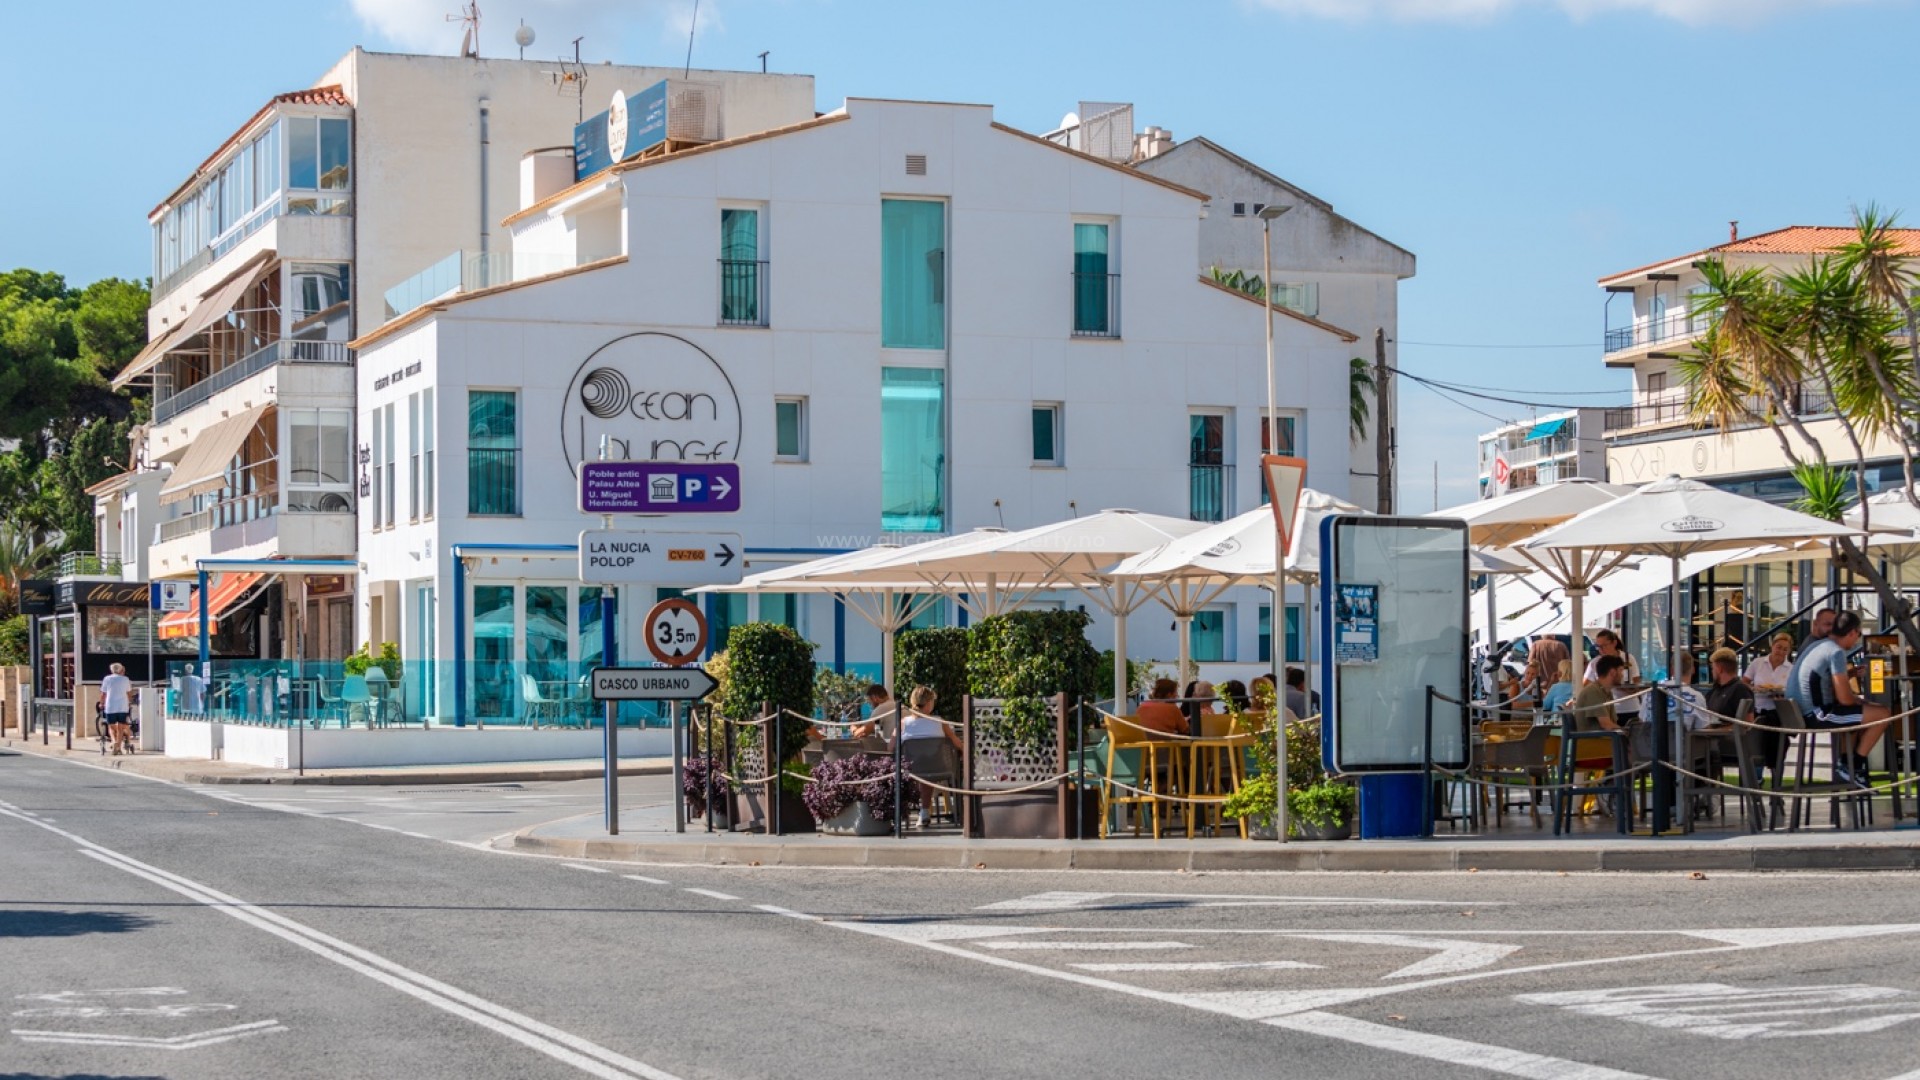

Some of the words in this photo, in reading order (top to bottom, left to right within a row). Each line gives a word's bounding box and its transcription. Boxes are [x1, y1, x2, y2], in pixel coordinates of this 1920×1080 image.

[580, 366, 717, 421] Ocean
[588, 469, 615, 478] Poble
[617, 469, 640, 478] antic
[588, 480, 614, 488] Palau
[616, 480, 640, 488] Altea
[685, 478, 702, 498] P
[600, 490, 632, 500] Miguel
[588, 499, 639, 507] Hernández
[590, 542, 608, 553] LA
[610, 542, 651, 553] NUCIA
[669, 550, 704, 559] CV-760
[590, 556, 635, 567] POLOP
[599, 678, 638, 690] CASCO
[642, 678, 690, 690] URBANO
